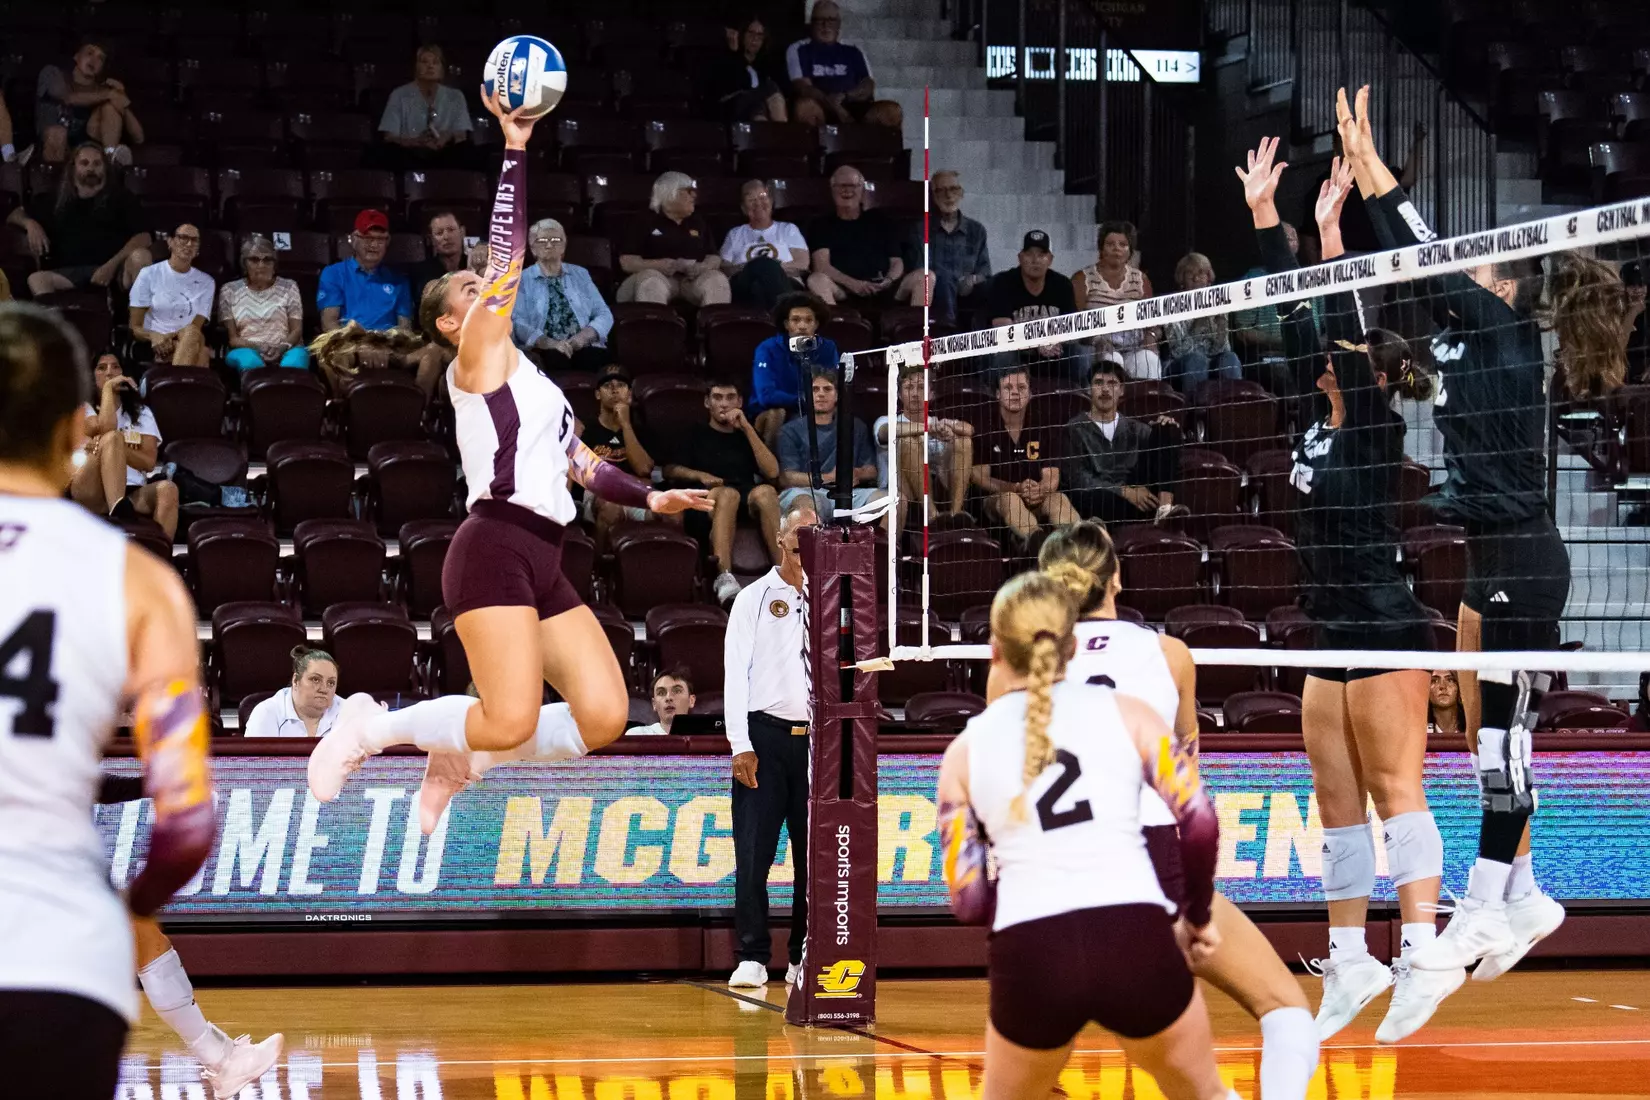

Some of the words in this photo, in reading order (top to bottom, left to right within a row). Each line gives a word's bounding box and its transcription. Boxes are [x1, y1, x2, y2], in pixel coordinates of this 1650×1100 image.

[496, 52, 511, 97] molten
[1157, 59, 1179, 73] 114
[491, 183, 515, 274] CHIPPEWAS
[947, 335, 970, 354] MICHIGAN
[970, 329, 998, 351] VOLLEYBALL
[1023, 322, 1047, 340] CENTRAL
[1047, 316, 1073, 337] MICHIGAN
[1074, 309, 1107, 333] VOLLEYBALL
[1136, 299, 1162, 321] CENTRAL
[1162, 293, 1192, 316] MICHIGAN
[1193, 285, 1232, 310] VOLLEYBALL
[1265, 273, 1295, 297] CENTRAL
[1297, 265, 1331, 291] MICHIGAN
[1332, 256, 1376, 284] VOLLEYBALL
[1417, 243, 1452, 268] CENTRAL
[1453, 233, 1495, 261] MICHIGAN
[1496, 221, 1548, 252] VOLLEYBALL
[1596, 205, 1638, 233] CENTRAL
[559, 404, 573, 444] 5
[1026, 441, 1040, 460] C
[0, 608, 60, 738] 4
[1035, 748, 1094, 832] 2
[357, 788, 453, 895] TO
[835, 824, 852, 878] sports
[305, 914, 372, 922] DAKTRONICS
[833, 880, 850, 946] imports
